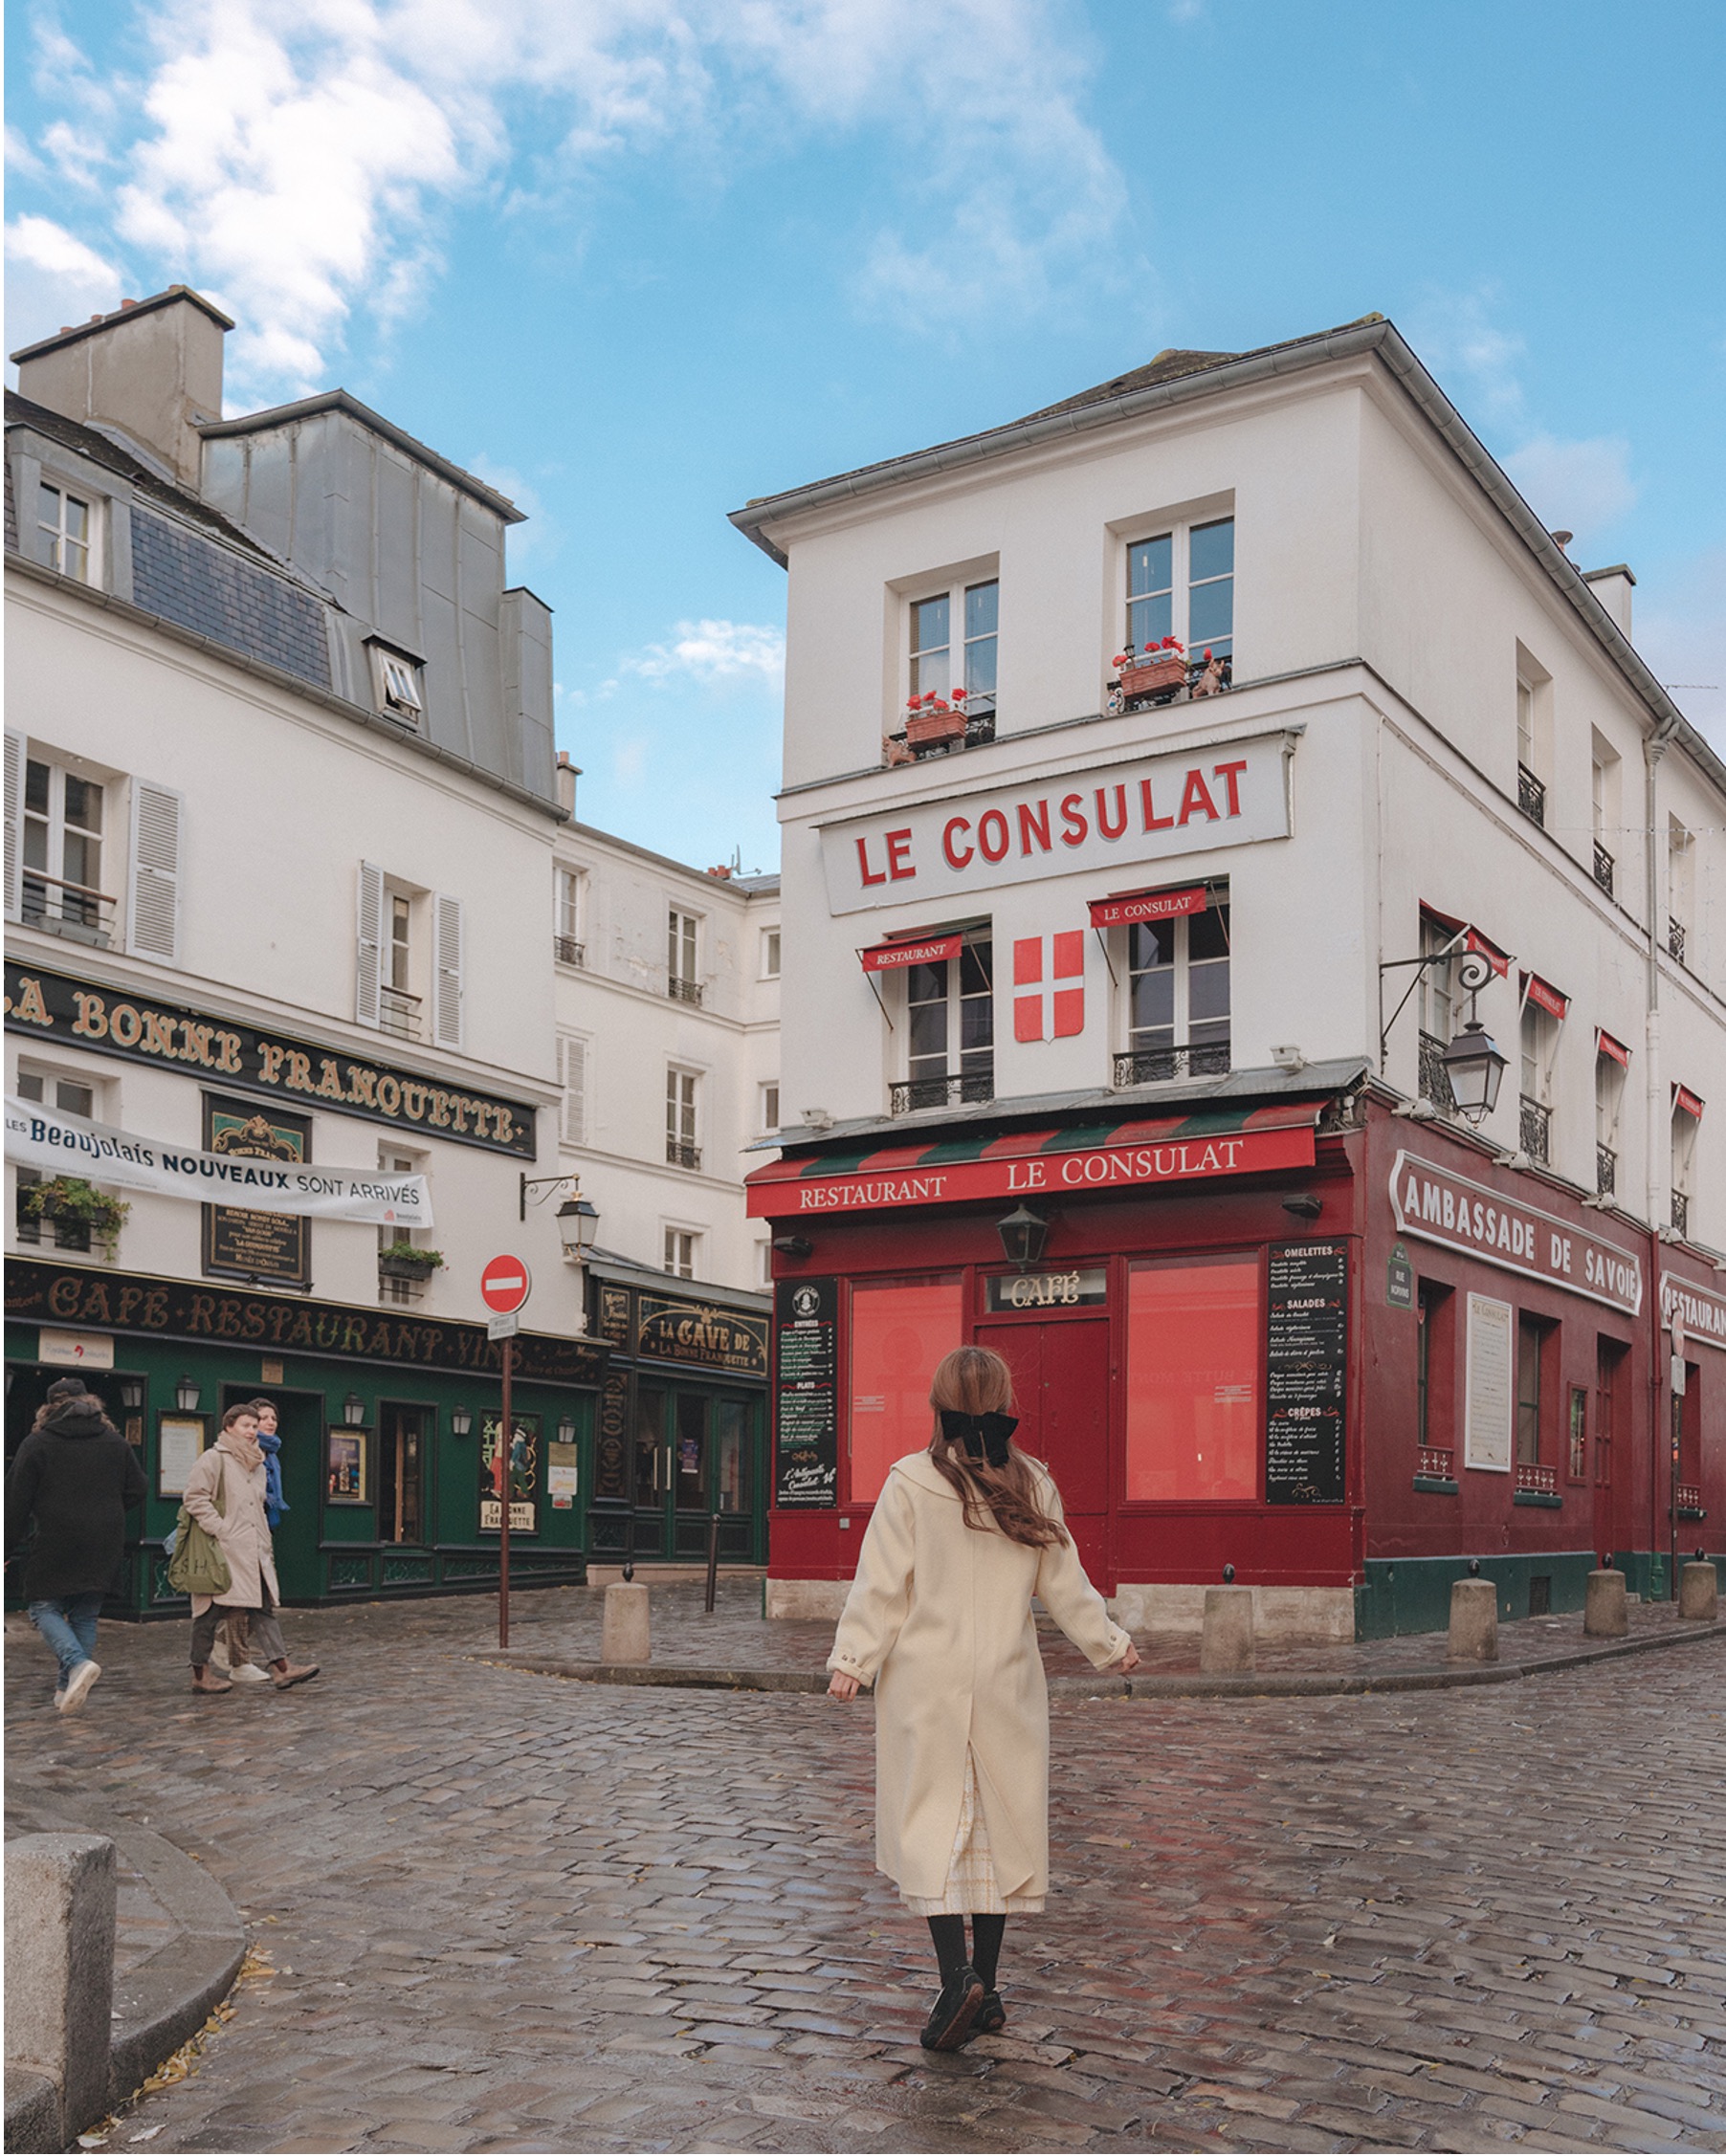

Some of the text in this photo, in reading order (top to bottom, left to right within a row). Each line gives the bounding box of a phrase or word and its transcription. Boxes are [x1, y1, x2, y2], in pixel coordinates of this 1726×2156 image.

[855, 759, 1248, 889] LE CONSULAT
[1103, 895, 1192, 921] LE CONSULAT
[875, 943, 946, 966] RESTAURANT
[4, 974, 515, 1144] A BONNE FRANQUETTE
[6, 1117, 28, 1133] LES
[30, 1117, 155, 1167] Beaujolais
[162, 1154, 290, 1190] NOUVEAUX
[297, 1176, 344, 1197] SONT
[350, 1182, 420, 1205] ARRIVÉS
[800, 1139, 1245, 1209] RESTAURANT LE CONSULAT
[1284, 1245, 1334, 1258] OMELETTES
[1404, 1175, 1637, 1302] AMBASSADE DE SAVOIE
[1009, 1270, 1081, 1308] CAFÉ
[1287, 1298, 1326, 1309] SALADES
[49, 1276, 169, 1330] CAFÉ
[186, 1293, 444, 1361] RESTAURANT
[659, 1319, 751, 1352] LA CAVE DE
[1287, 1406, 1321, 1418] CRÊPES
[484, 1514, 530, 1526] FRAUETTE
